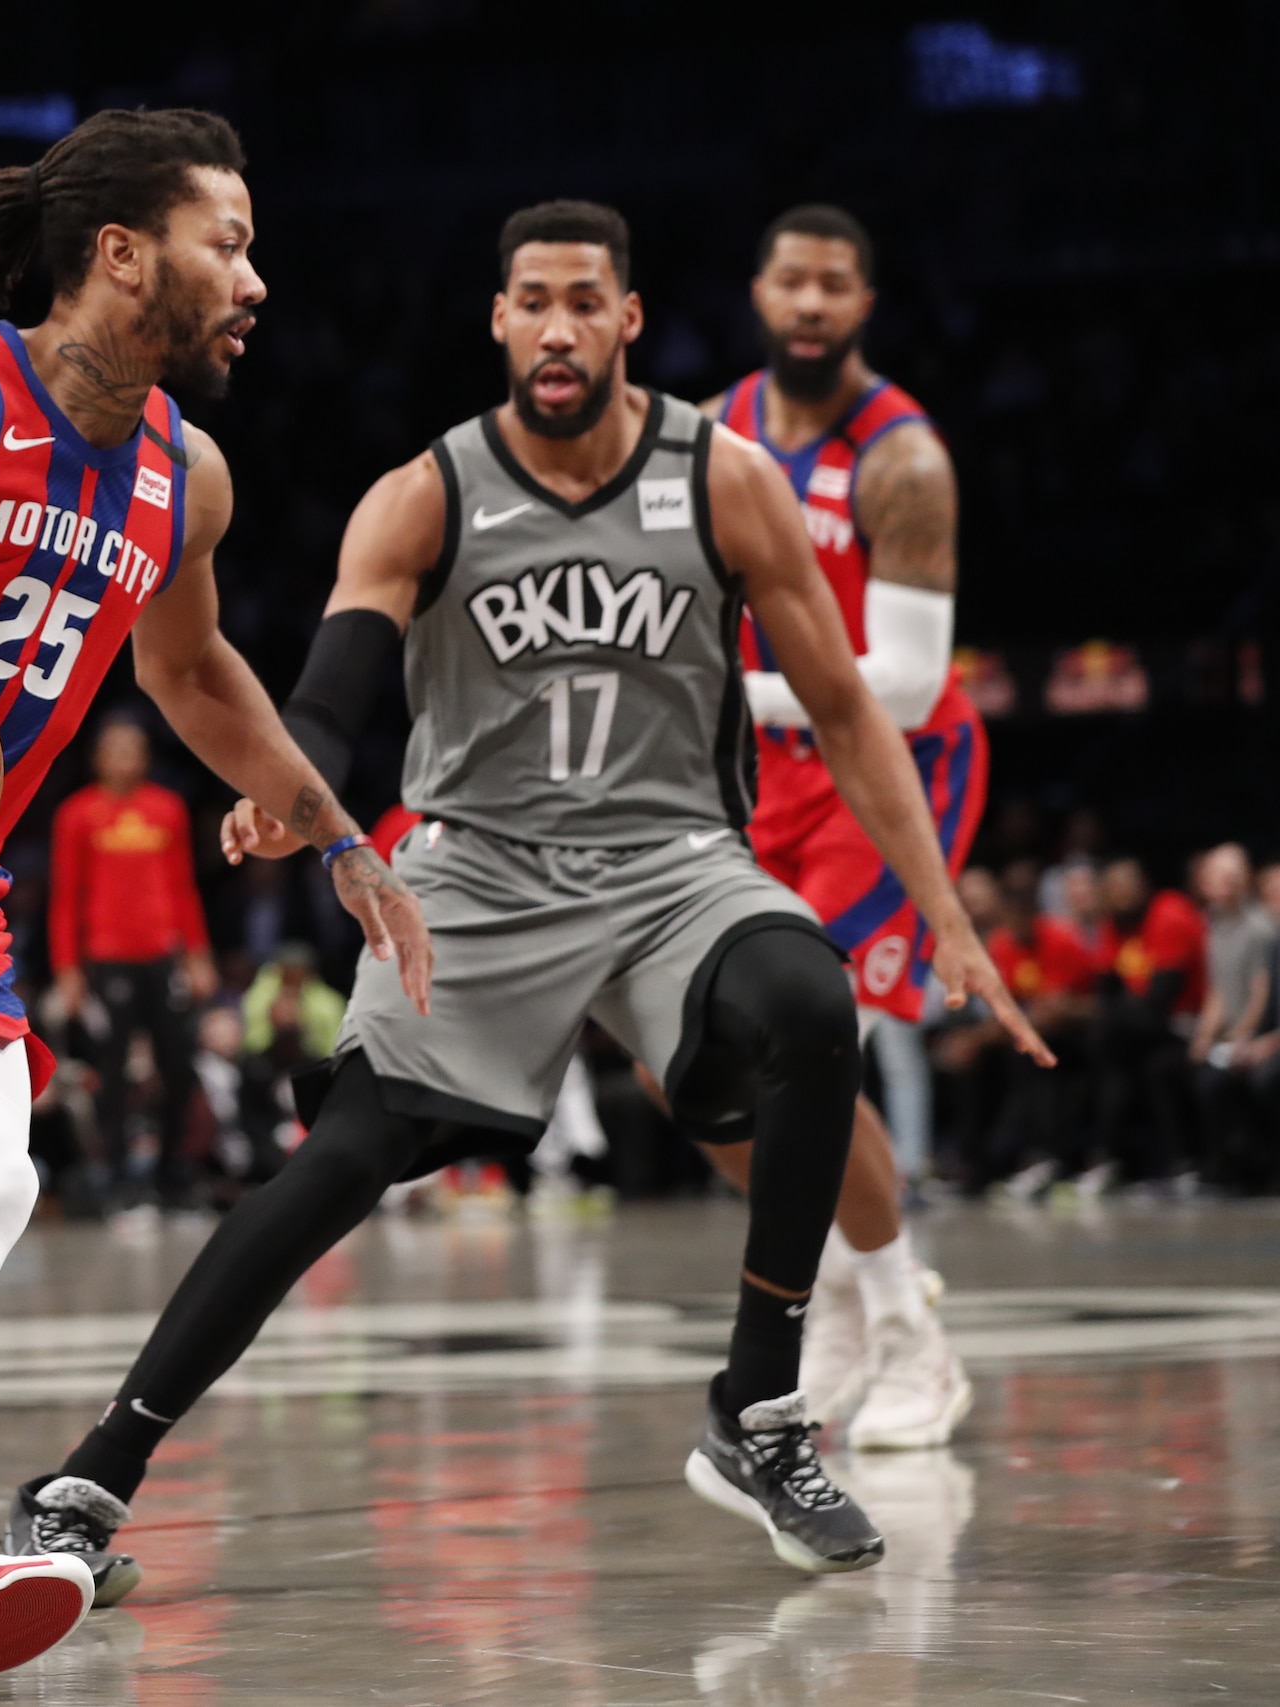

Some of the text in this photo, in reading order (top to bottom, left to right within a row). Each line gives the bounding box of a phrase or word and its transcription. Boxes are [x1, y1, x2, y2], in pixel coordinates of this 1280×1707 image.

[97, 530, 160, 604] CITY
[468, 562, 695, 666] BKLYN
[539, 672, 619, 780] 17
